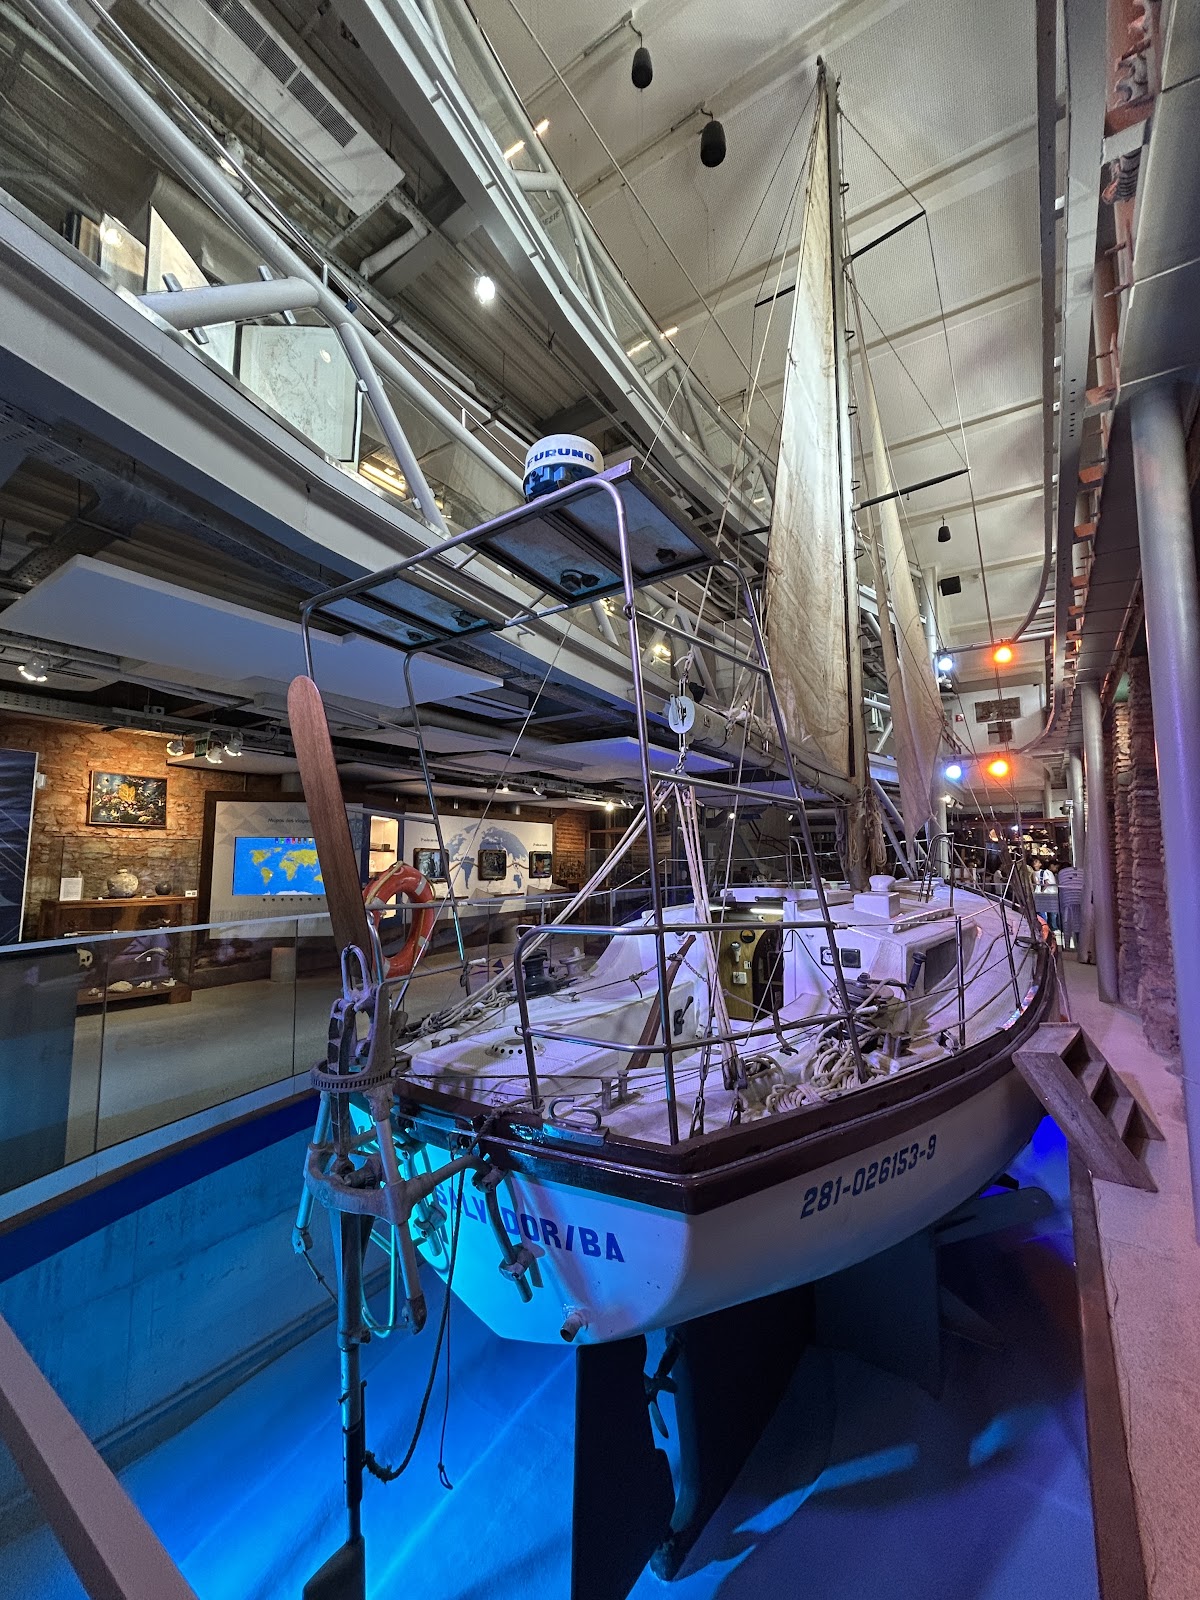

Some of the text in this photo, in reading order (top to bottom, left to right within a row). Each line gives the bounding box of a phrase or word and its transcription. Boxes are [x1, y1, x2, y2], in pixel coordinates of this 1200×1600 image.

[527, 448, 595, 469] FURUNO
[800, 1133, 937, 1220] 281-026153-9
[435, 1184, 625, 1263] SALVDOR/BA
